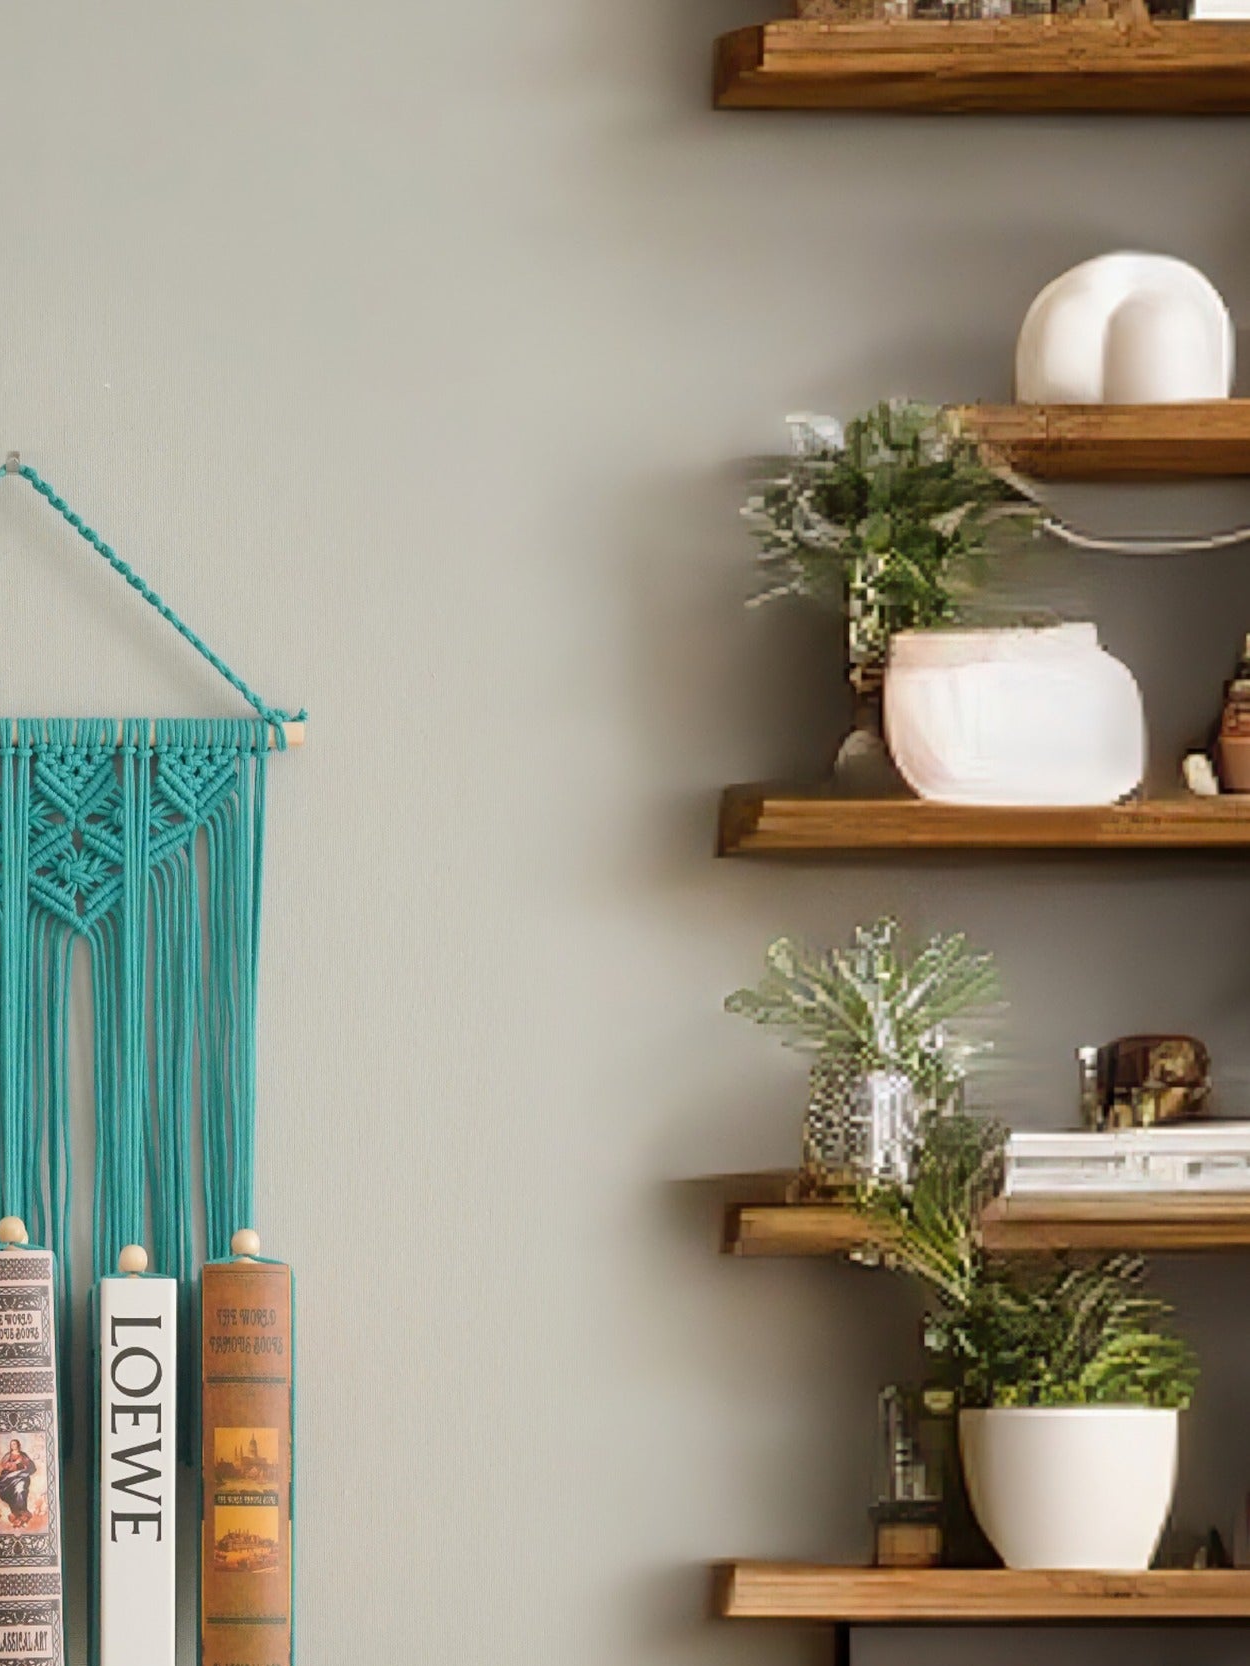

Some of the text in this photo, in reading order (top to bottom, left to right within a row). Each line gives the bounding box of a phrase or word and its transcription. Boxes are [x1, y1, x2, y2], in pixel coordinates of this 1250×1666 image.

[216, 1309, 276, 1328] THE WORLD
[110, 1315, 162, 1543] LOEWE
[34, 1630, 47, 1651] ART
